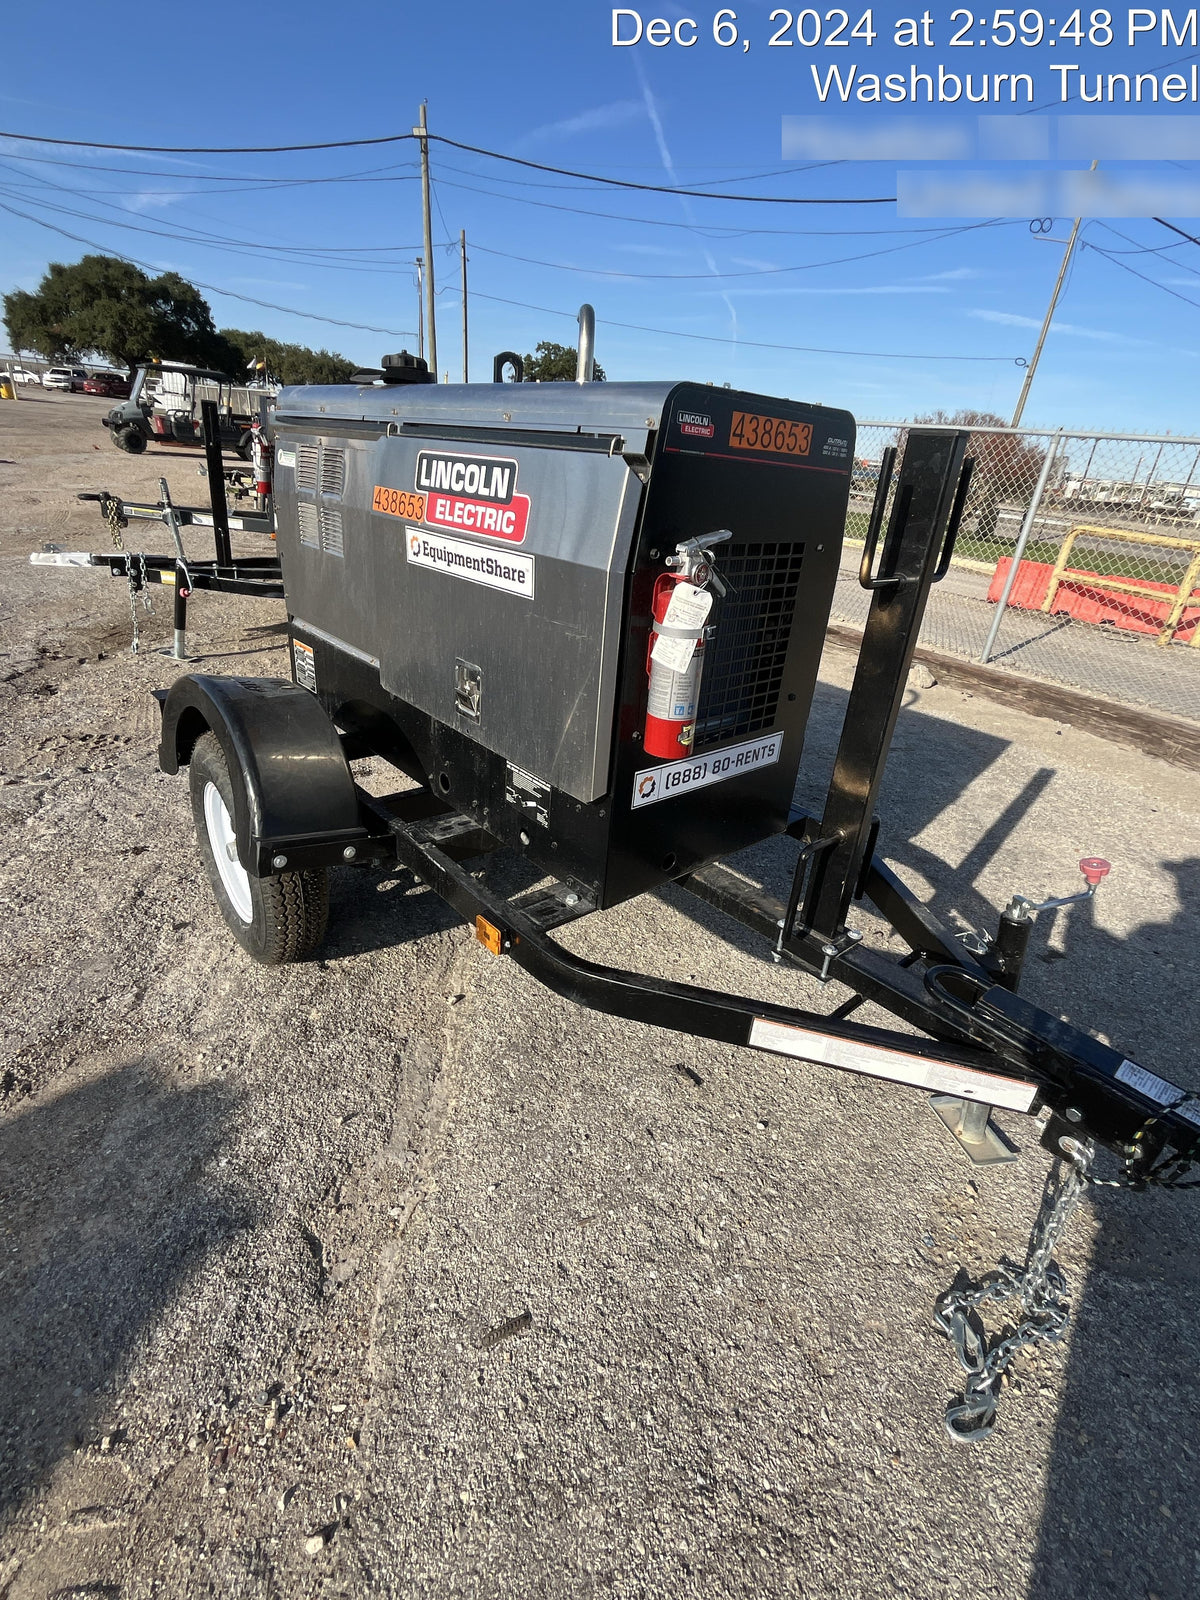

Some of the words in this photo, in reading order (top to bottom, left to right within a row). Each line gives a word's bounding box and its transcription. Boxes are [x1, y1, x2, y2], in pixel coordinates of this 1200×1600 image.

[678, 412, 709, 426] LINCOLN
[684, 426, 711, 436] ELECTRIC
[732, 413, 811, 453] 438653
[419, 457, 511, 499] LINCOLN
[373, 487, 425, 520] 438653
[434, 498, 517, 534] ELECTRIC
[422, 540, 526, 584] EquipmentShare
[665, 762, 708, 790] (888)
[712, 743, 776, 775] 80-RENTS
